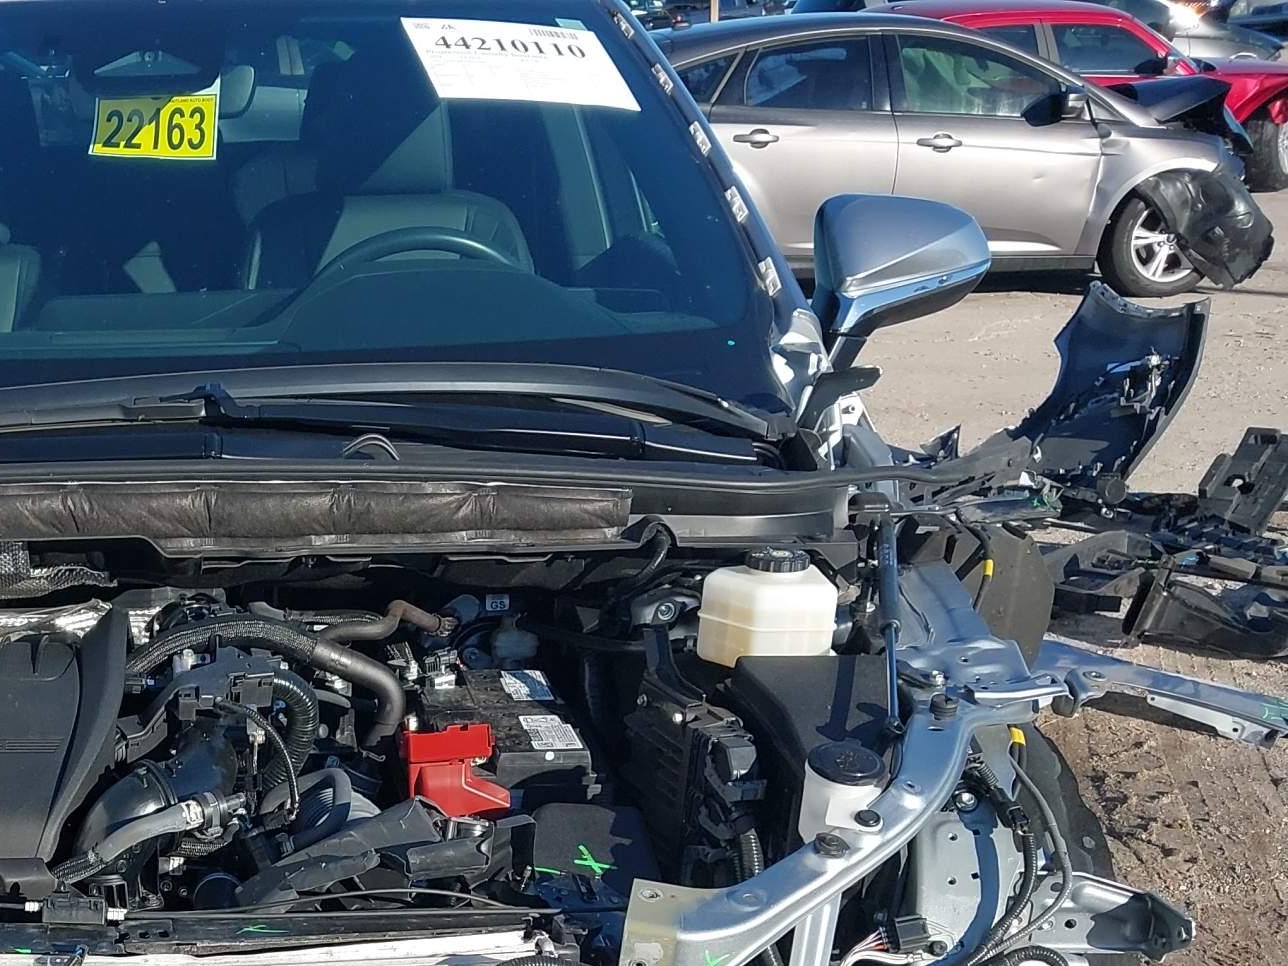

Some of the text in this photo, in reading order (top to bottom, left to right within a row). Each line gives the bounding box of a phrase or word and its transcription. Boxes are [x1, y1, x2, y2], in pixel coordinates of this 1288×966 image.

[435, 35, 586, 58] 44210110
[102, 107, 206, 150] 22163
[490, 600, 506, 610] GS
